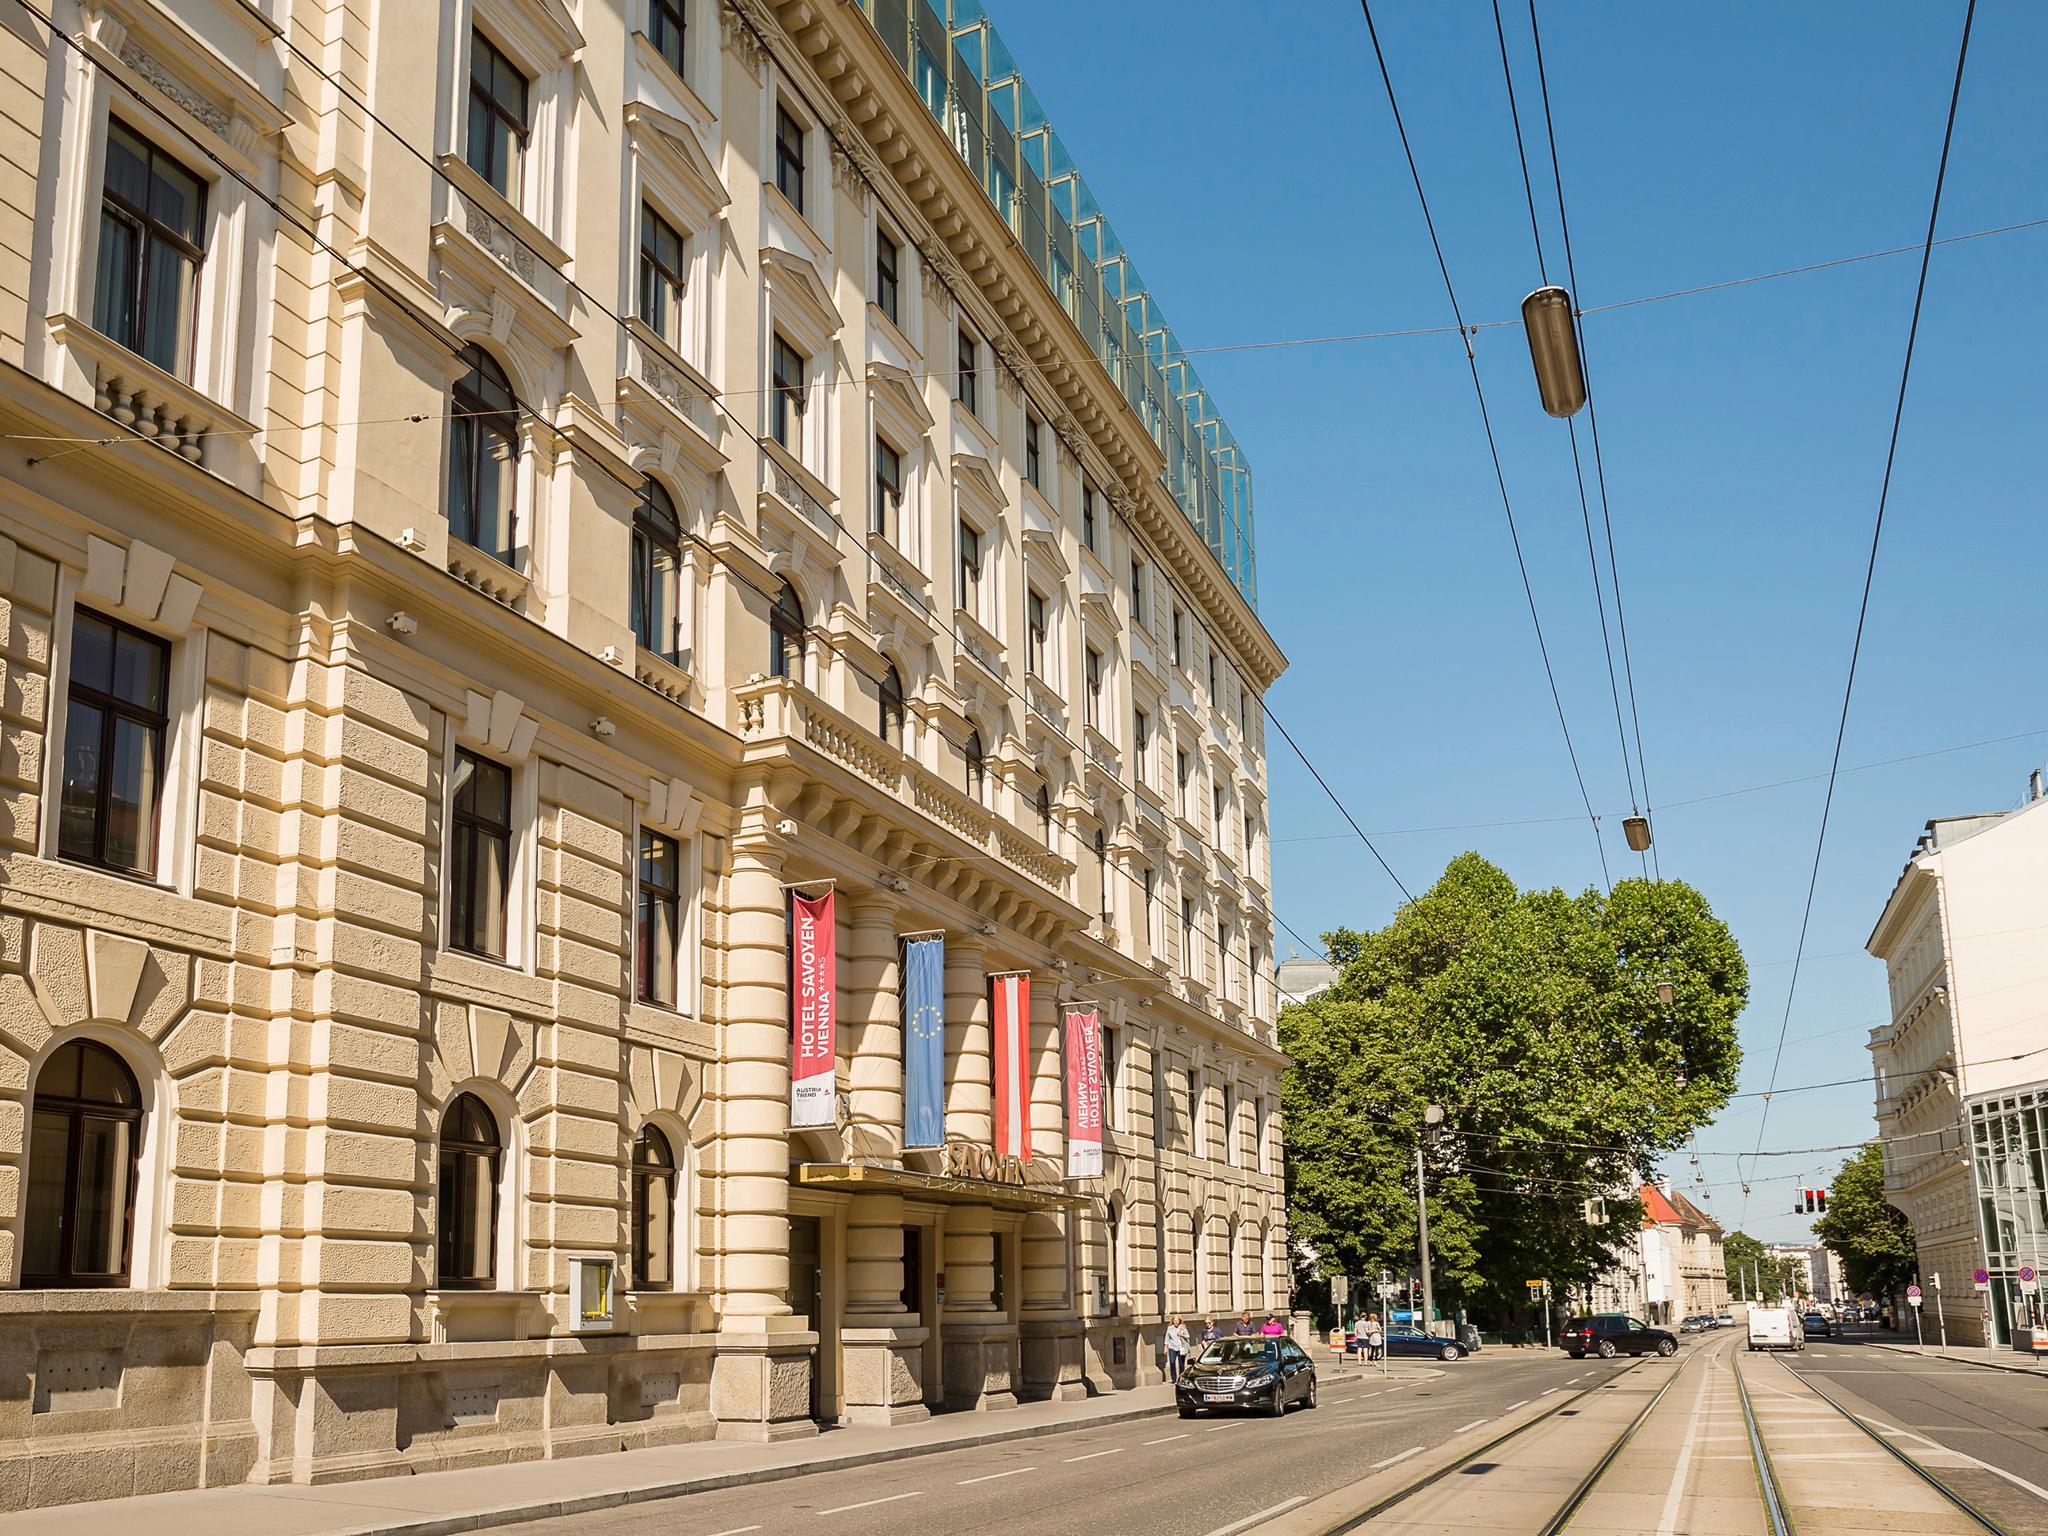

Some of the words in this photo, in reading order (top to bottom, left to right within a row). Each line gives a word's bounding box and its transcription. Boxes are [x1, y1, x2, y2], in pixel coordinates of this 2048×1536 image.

[800, 917, 815, 997] SAVOYEN
[801, 1000, 815, 1058] HOTEL
[816, 991, 830, 1058] VIENNA
